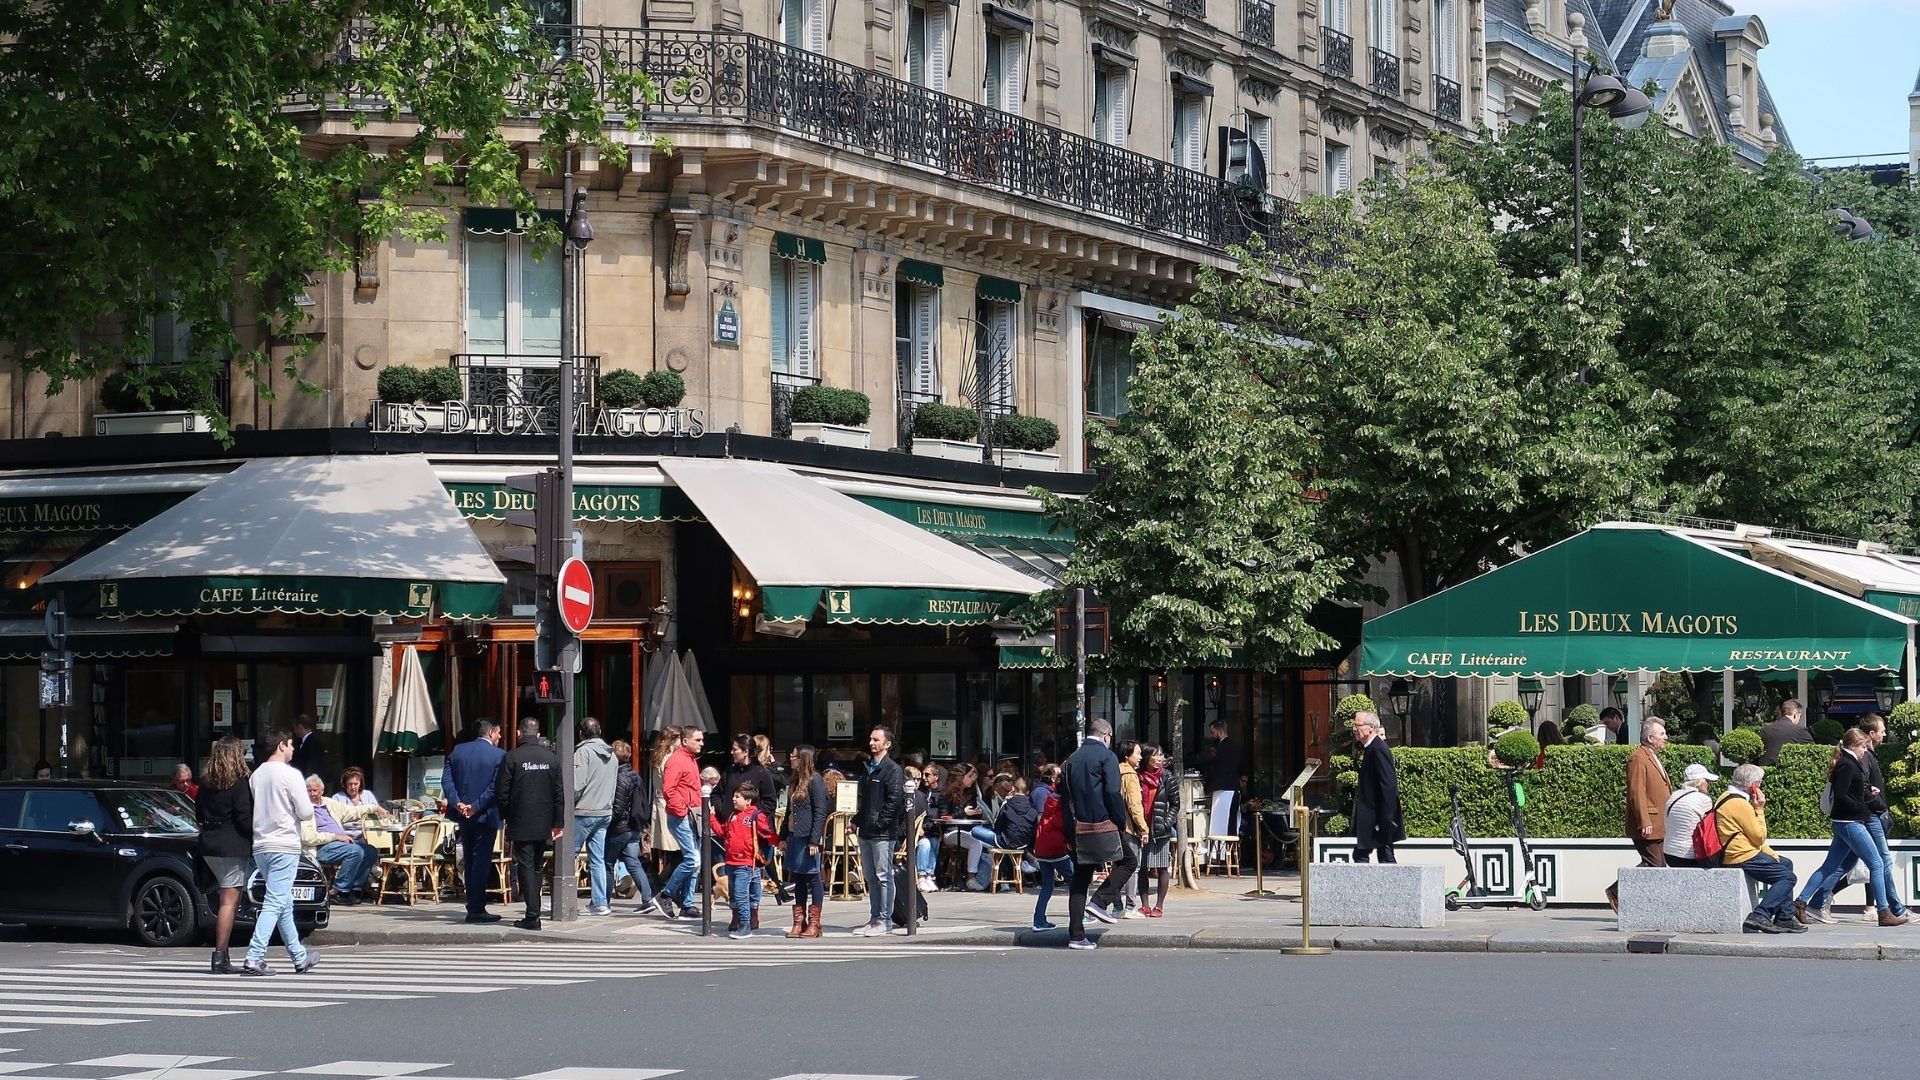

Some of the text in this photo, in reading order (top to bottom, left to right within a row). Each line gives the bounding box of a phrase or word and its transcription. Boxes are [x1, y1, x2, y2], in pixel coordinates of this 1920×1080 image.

[370, 399, 429, 434] LES
[441, 399, 546, 436] DEUX
[449, 489, 640, 511] LES DEU AGOTS
[0, 503, 101, 522] EUX MAGOTS
[917, 506, 986, 530] LES DEUX MAGOTS
[200, 587, 319, 602] CAFE Littéraire
[928, 599, 1001, 614] RESTAURANT
[1519, 610, 1738, 635] LES DEUX MAGOTS
[1407, 652, 1528, 666] CAFE Littéraire
[1729, 650, 1851, 661] RESTAURANT
